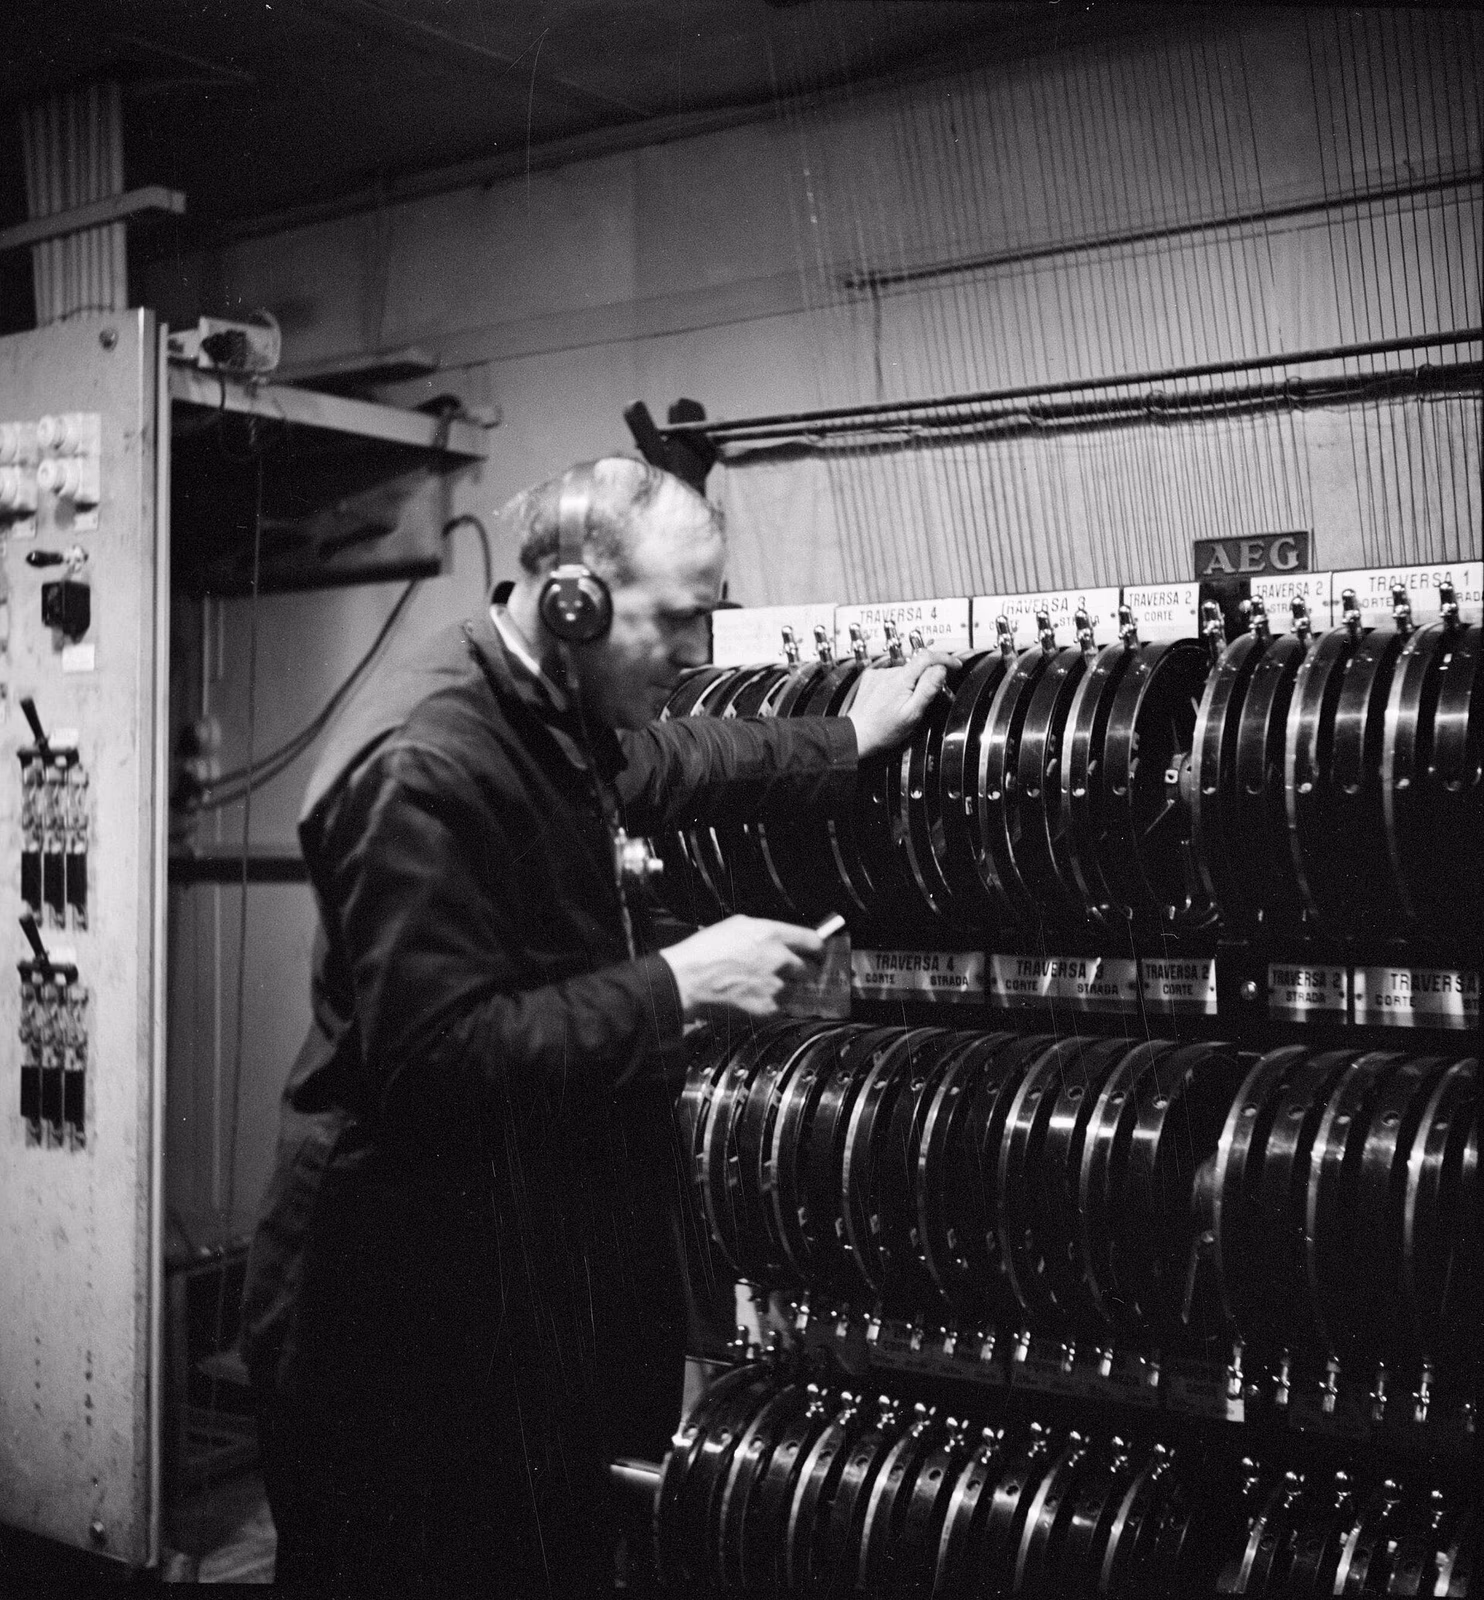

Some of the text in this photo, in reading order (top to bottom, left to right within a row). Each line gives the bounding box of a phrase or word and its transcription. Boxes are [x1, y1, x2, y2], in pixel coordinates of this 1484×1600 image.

[1202, 537, 1299, 574] AEG
[1256, 581, 1323, 598] TRAVERSA 2
[1369, 570, 1470, 592] TRAVERSA 1
[1000, 596, 1086, 615] TRAVERSA 3
[1129, 591, 1192, 607] TRAVERSA 2
[1360, 597, 1393, 608] ORTE
[860, 606, 937, 623] TRAVERSA 4
[1144, 610, 1173, 621] CORTE
[875, 954, 954, 971] TRAVERSA 4
[1016, 960, 1086, 978] TRAVERSA
[865, 973, 968, 987] CORTE STRADA
[1145, 963, 1209, 980] TRAVERSA 2
[1273, 970, 1341, 988] TRAVERSA 2
[1005, 979, 1119, 995] CORTE STRADA
[1162, 983, 1193, 996] CORTE
[1391, 973, 1477, 993] TRAVERSA
[1376, 994, 1416, 1008] CORTE
